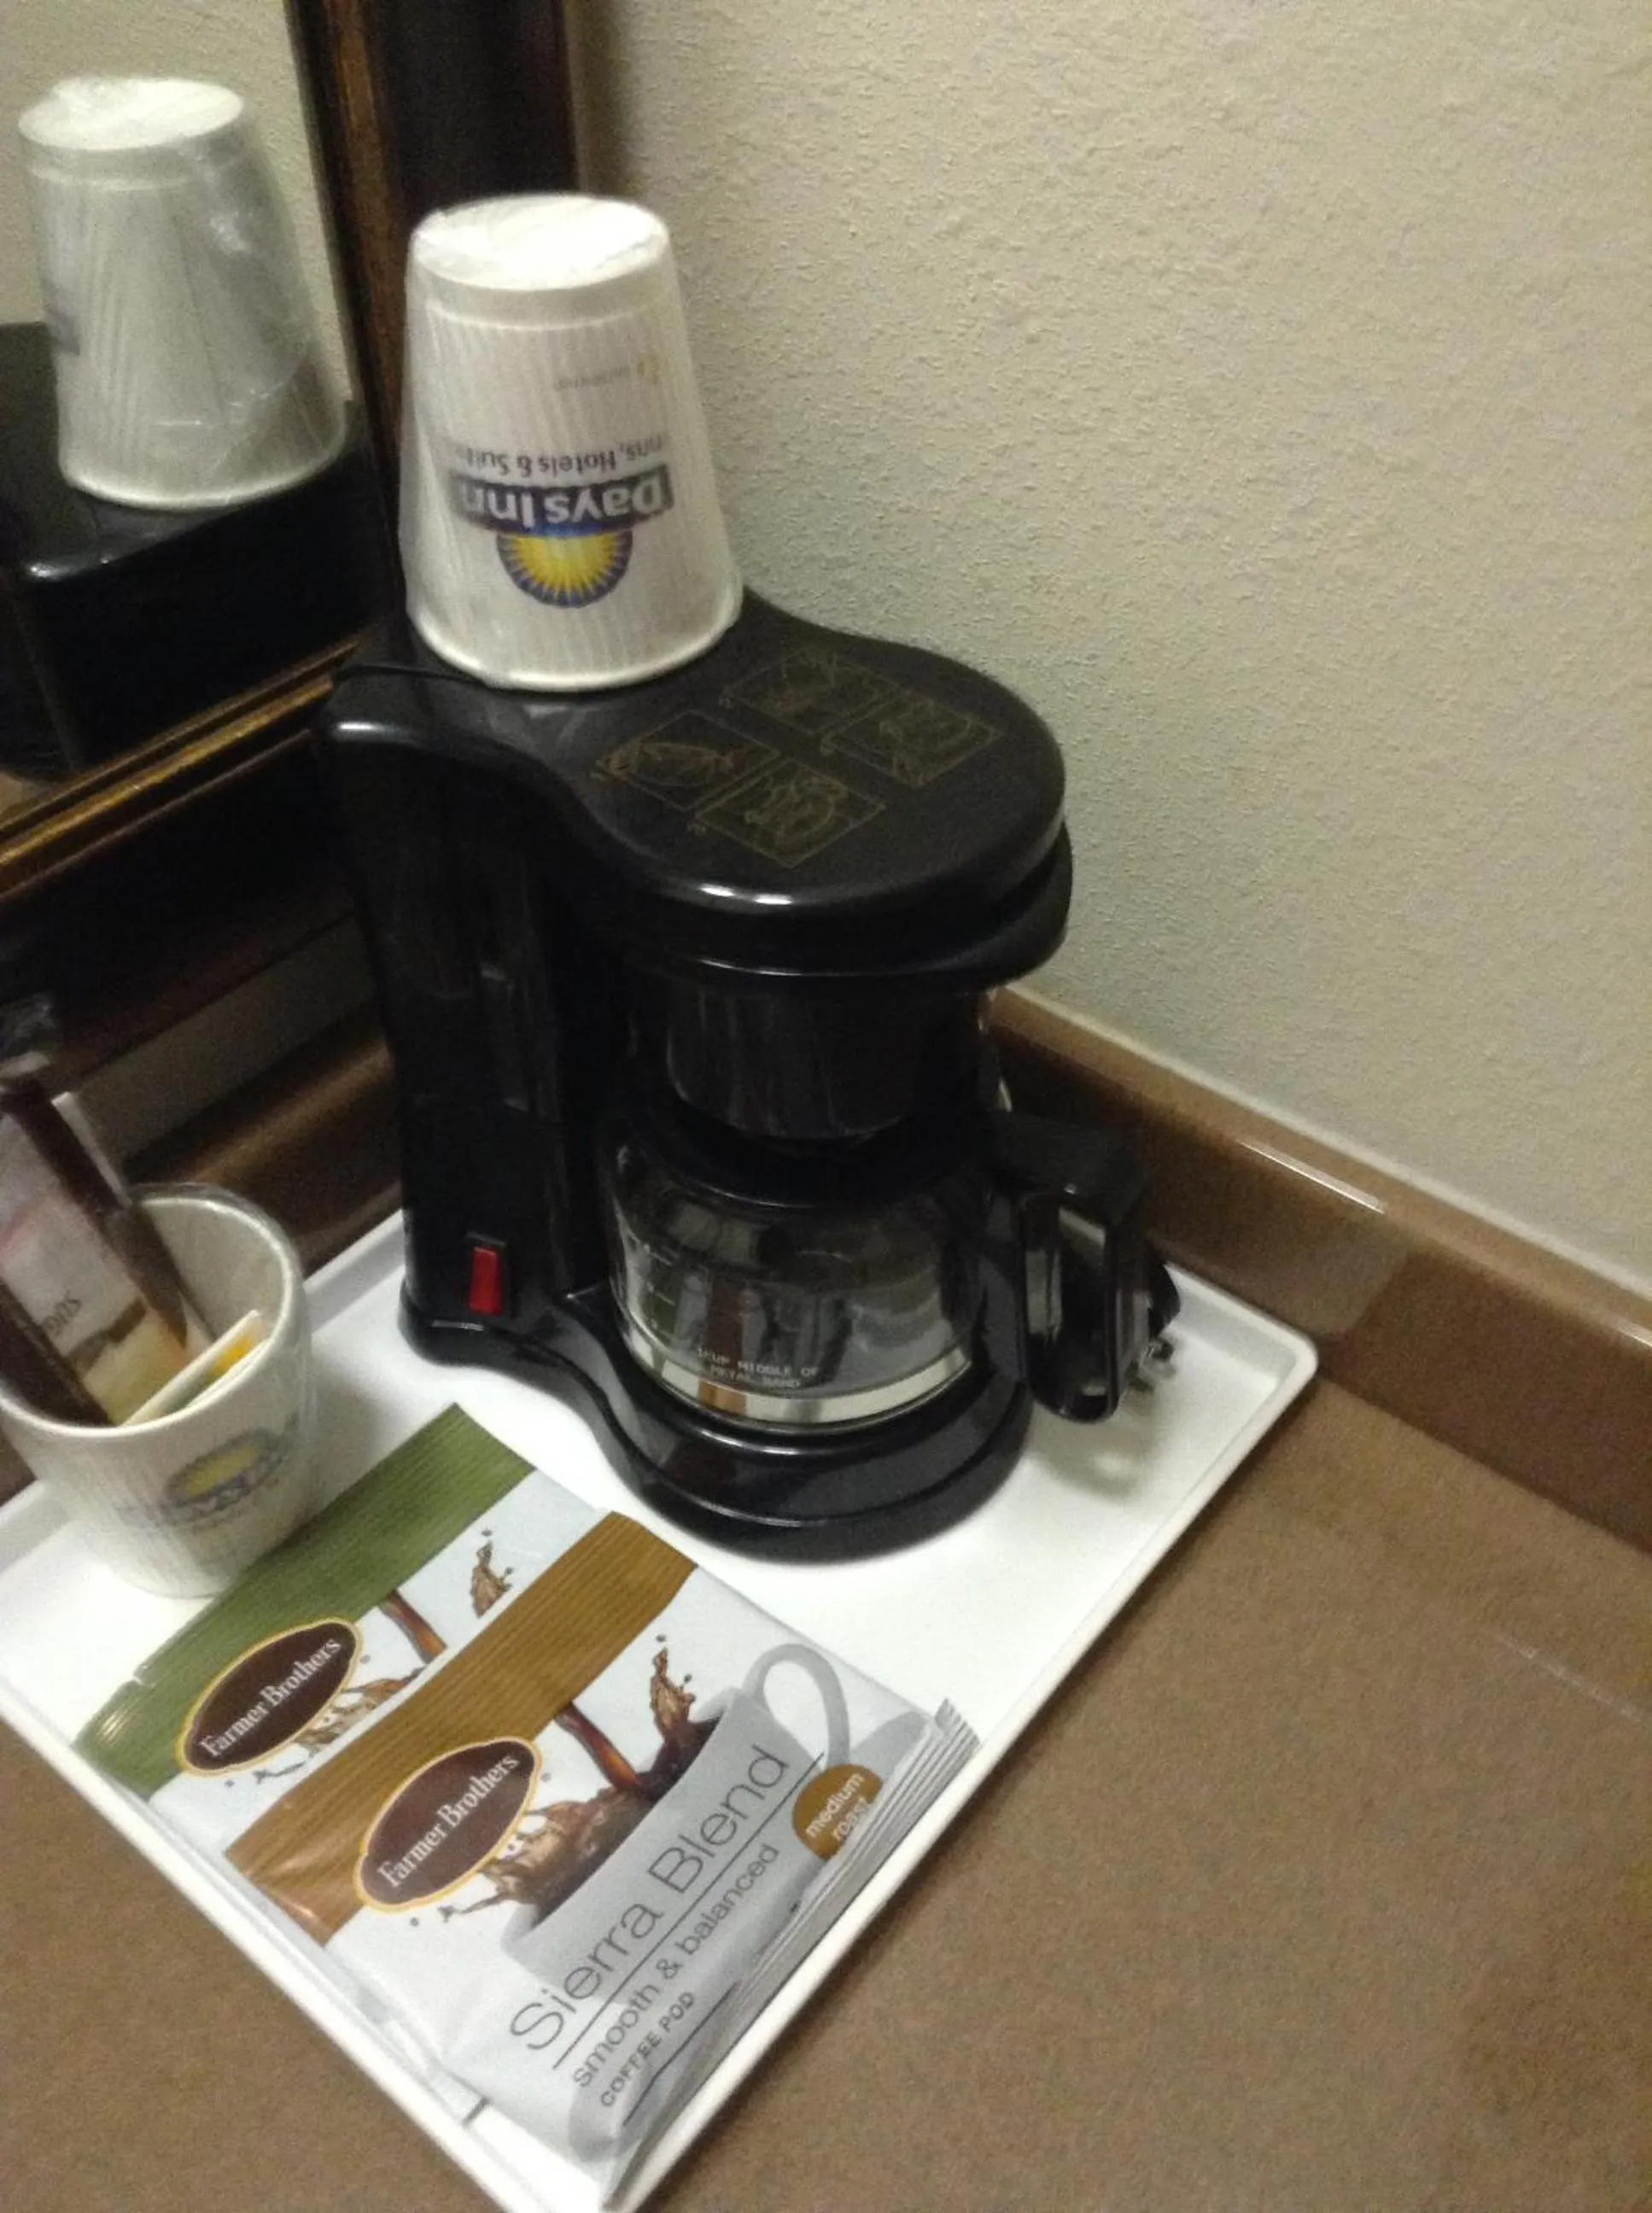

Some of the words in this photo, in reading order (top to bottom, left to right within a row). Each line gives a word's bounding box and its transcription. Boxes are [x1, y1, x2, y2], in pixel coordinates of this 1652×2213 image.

[461, 482, 534, 528] Inn
[517, 455, 532, 477] &
[539, 449, 616, 478] Hotels
[543, 475, 663, 523] Days
[200, 1700, 270, 1758] Farmer
[260, 1638, 341, 1708] Brothers
[377, 1819, 450, 1888] Farmer
[439, 1754, 519, 1825] Brothers
[805, 1771, 866, 1839] medium
[511, 1902, 663, 2051] Sierra
[648, 1743, 791, 1894] Blend
[574, 1983, 659, 2088] smooth
[656, 1958, 680, 1981] &
[677, 1843, 780, 1956] balanced
[600, 2029, 662, 2108] COFFEE
[659, 1992, 694, 2033] POD
